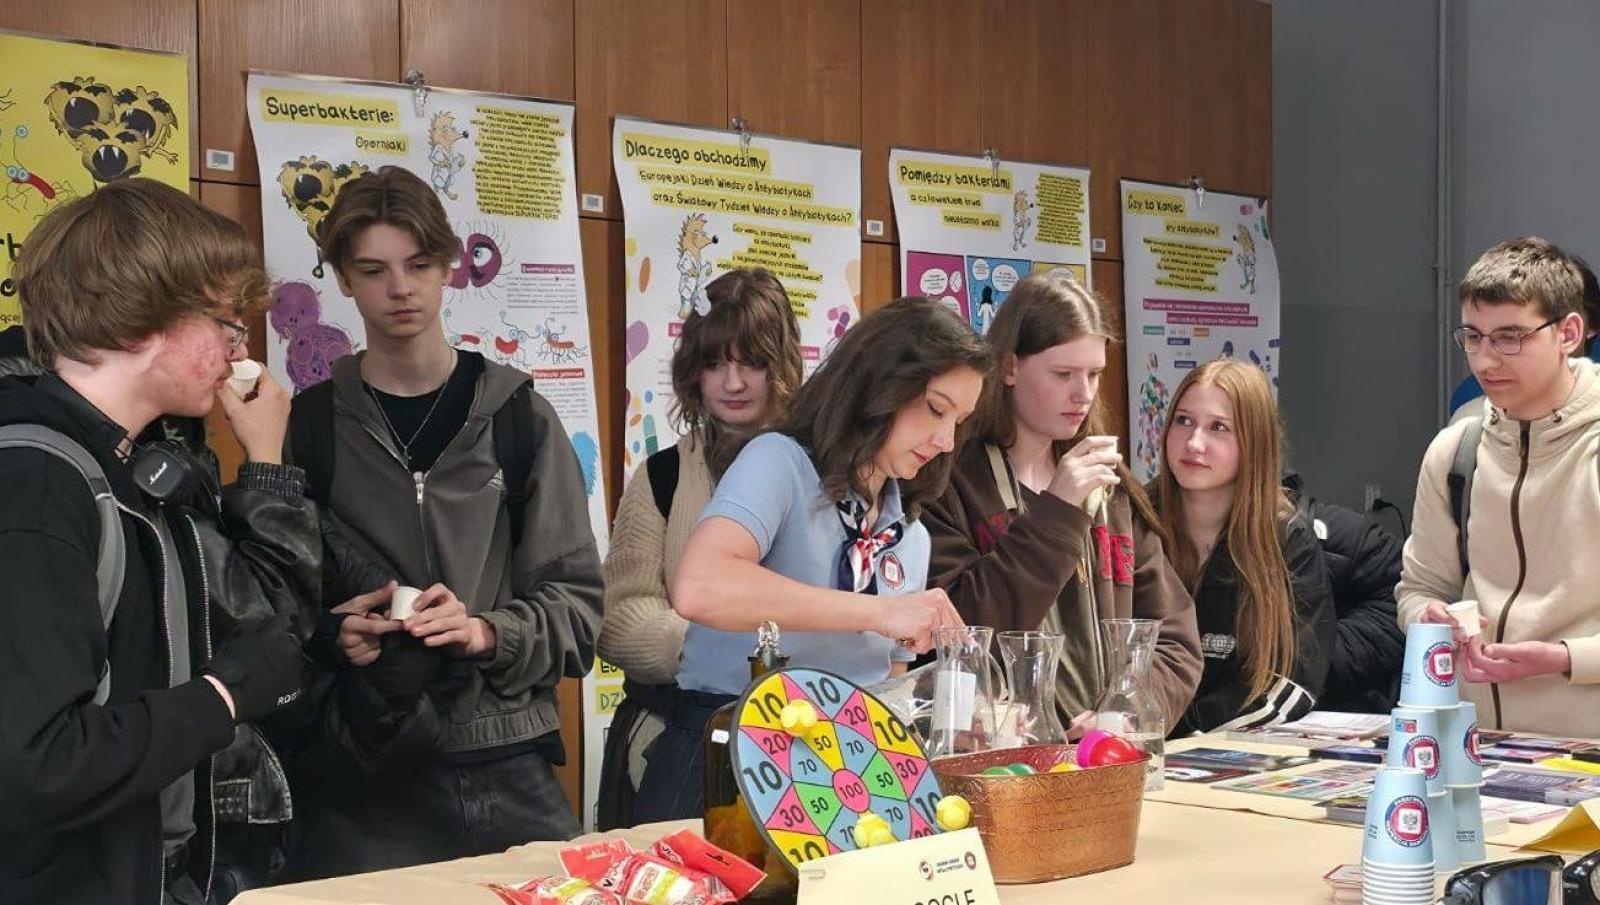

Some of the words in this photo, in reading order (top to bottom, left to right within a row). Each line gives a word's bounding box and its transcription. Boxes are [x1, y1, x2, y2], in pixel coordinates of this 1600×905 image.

[266, 96, 394, 123] Superbakterie:
[625, 140, 689, 164] Dlaczego
[693, 149, 767, 171] obchodzimy
[639, 170, 690, 185] Europejski
[691, 175, 714, 186] Dzień
[899, 165, 952, 185] Pomiędzy
[955, 173, 1010, 190] bakteriami
[652, 193, 674, 203] oraz
[676, 191, 718, 209] Światowy
[1128, 194, 1143, 212] Czy
[1144, 199, 1154, 210] to
[806, 677, 841, 707] 10
[749, 692, 785, 724] 10
[844, 707, 868, 726] 20
[874, 716, 908, 746] 10
[763, 733, 787, 754] 20
[813, 734, 832, 751] 50
[846, 740, 864, 756] 70
[798, 758, 817, 775] 70
[896, 758, 919, 779] 30
[743, 760, 782, 794] 10
[876, 771, 894, 788] 50
[839, 782, 863, 799] 100
[810, 796, 828, 814] 50
[885, 806, 904, 823] 70
[779, 804, 805, 828] 30
